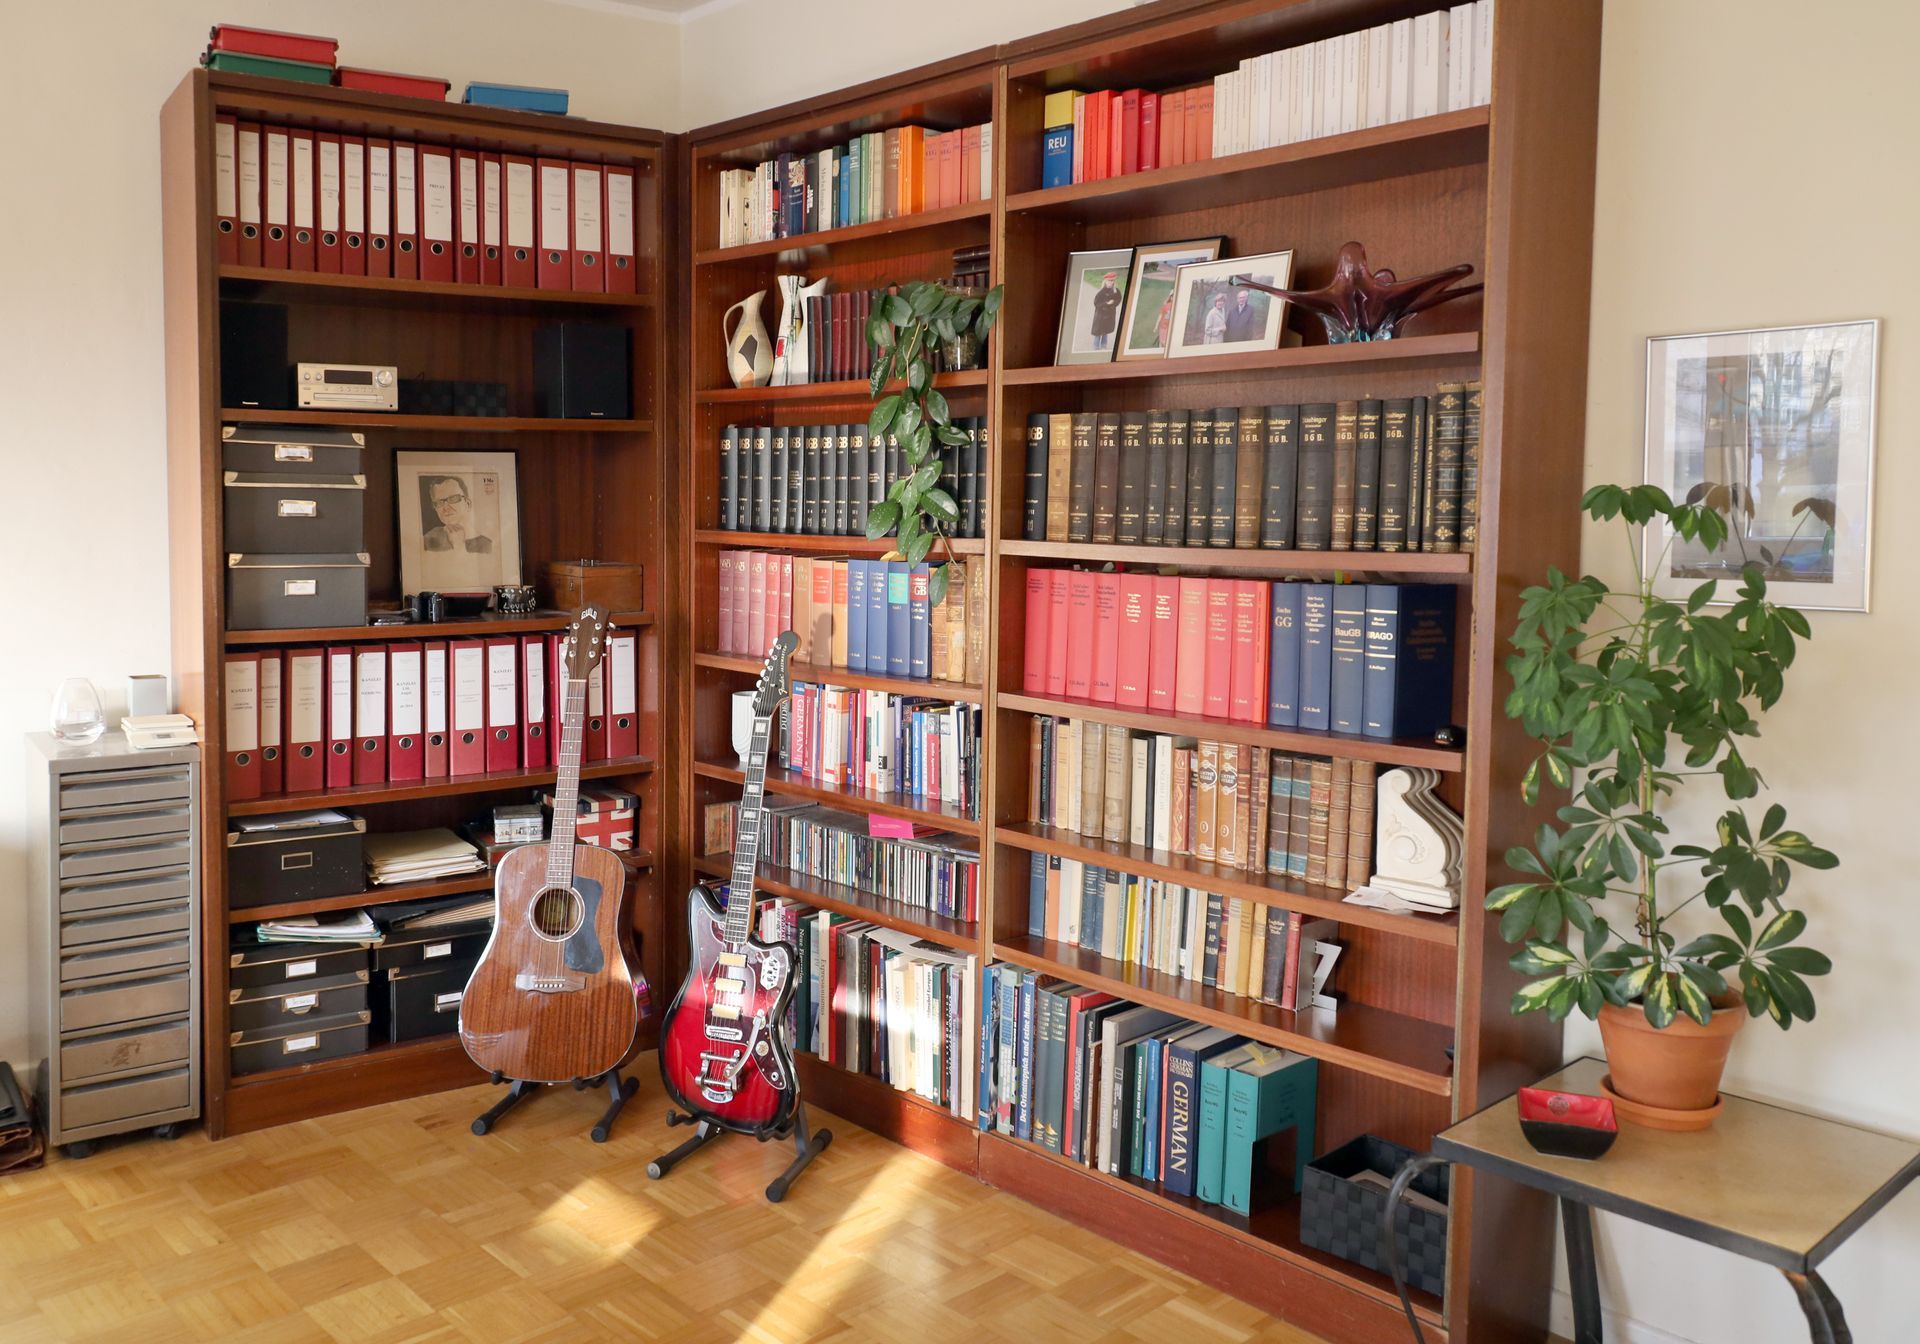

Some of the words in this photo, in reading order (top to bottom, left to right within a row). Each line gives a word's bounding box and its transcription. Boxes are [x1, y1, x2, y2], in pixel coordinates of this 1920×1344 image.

[1048, 136, 1067, 150] REU
[581, 607, 598, 620] GUILD
[1275, 615, 1293, 628] GG
[1335, 627, 1361, 638] BauGB
[1367, 631, 1394, 641] BRAGO
[778, 674, 788, 696] Fender
[797, 699, 805, 753] GERMAN
[1023, 993, 1031, 1019] Muster
[1169, 1056, 1194, 1068] COLLINS
[1169, 1062, 1193, 1073] GERMAN
[1169, 1068, 1193, 1079] DICTIONARY
[1020, 1058, 1030, 1108] Orientteppich
[1073, 1070, 1081, 1104] DESIGN
[1170, 1081, 1189, 1175] GERMAN
